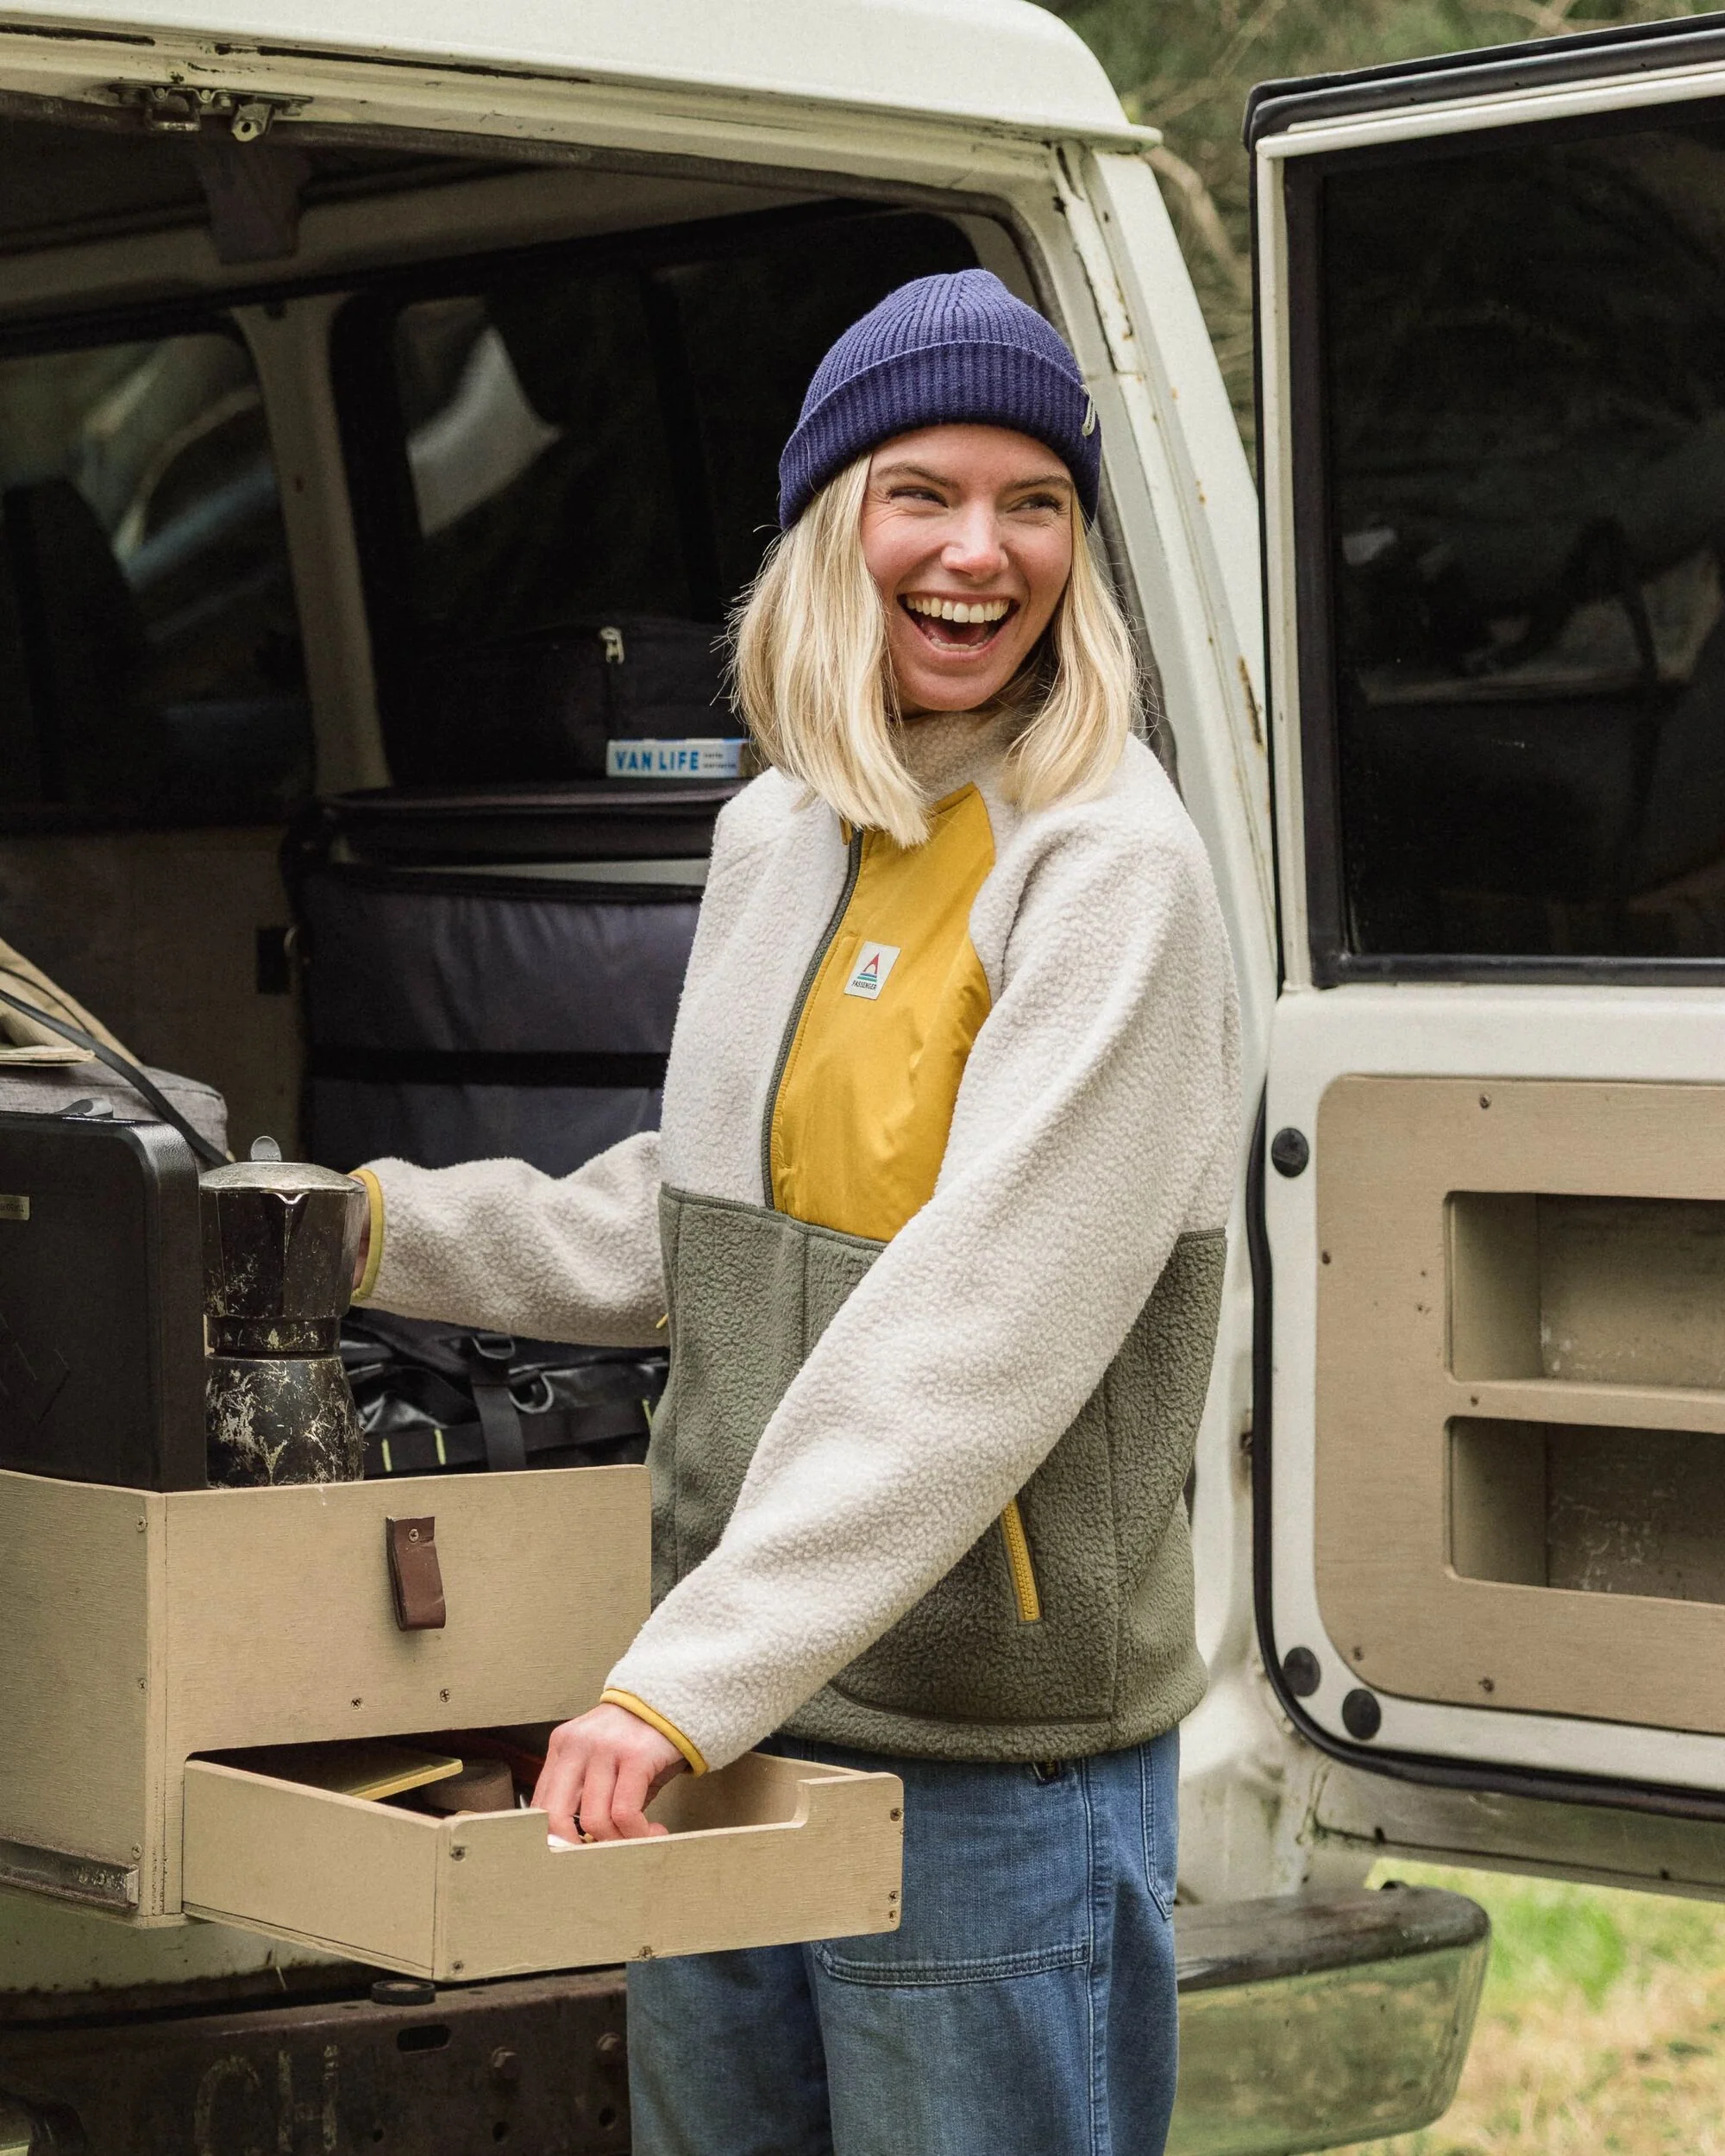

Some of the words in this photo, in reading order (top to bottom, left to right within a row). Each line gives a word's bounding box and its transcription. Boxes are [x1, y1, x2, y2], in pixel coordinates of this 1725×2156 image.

[616, 752, 652, 770] VAN
[660, 752, 699, 770] LIFE
[851, 980, 877, 991] PASSENGER
